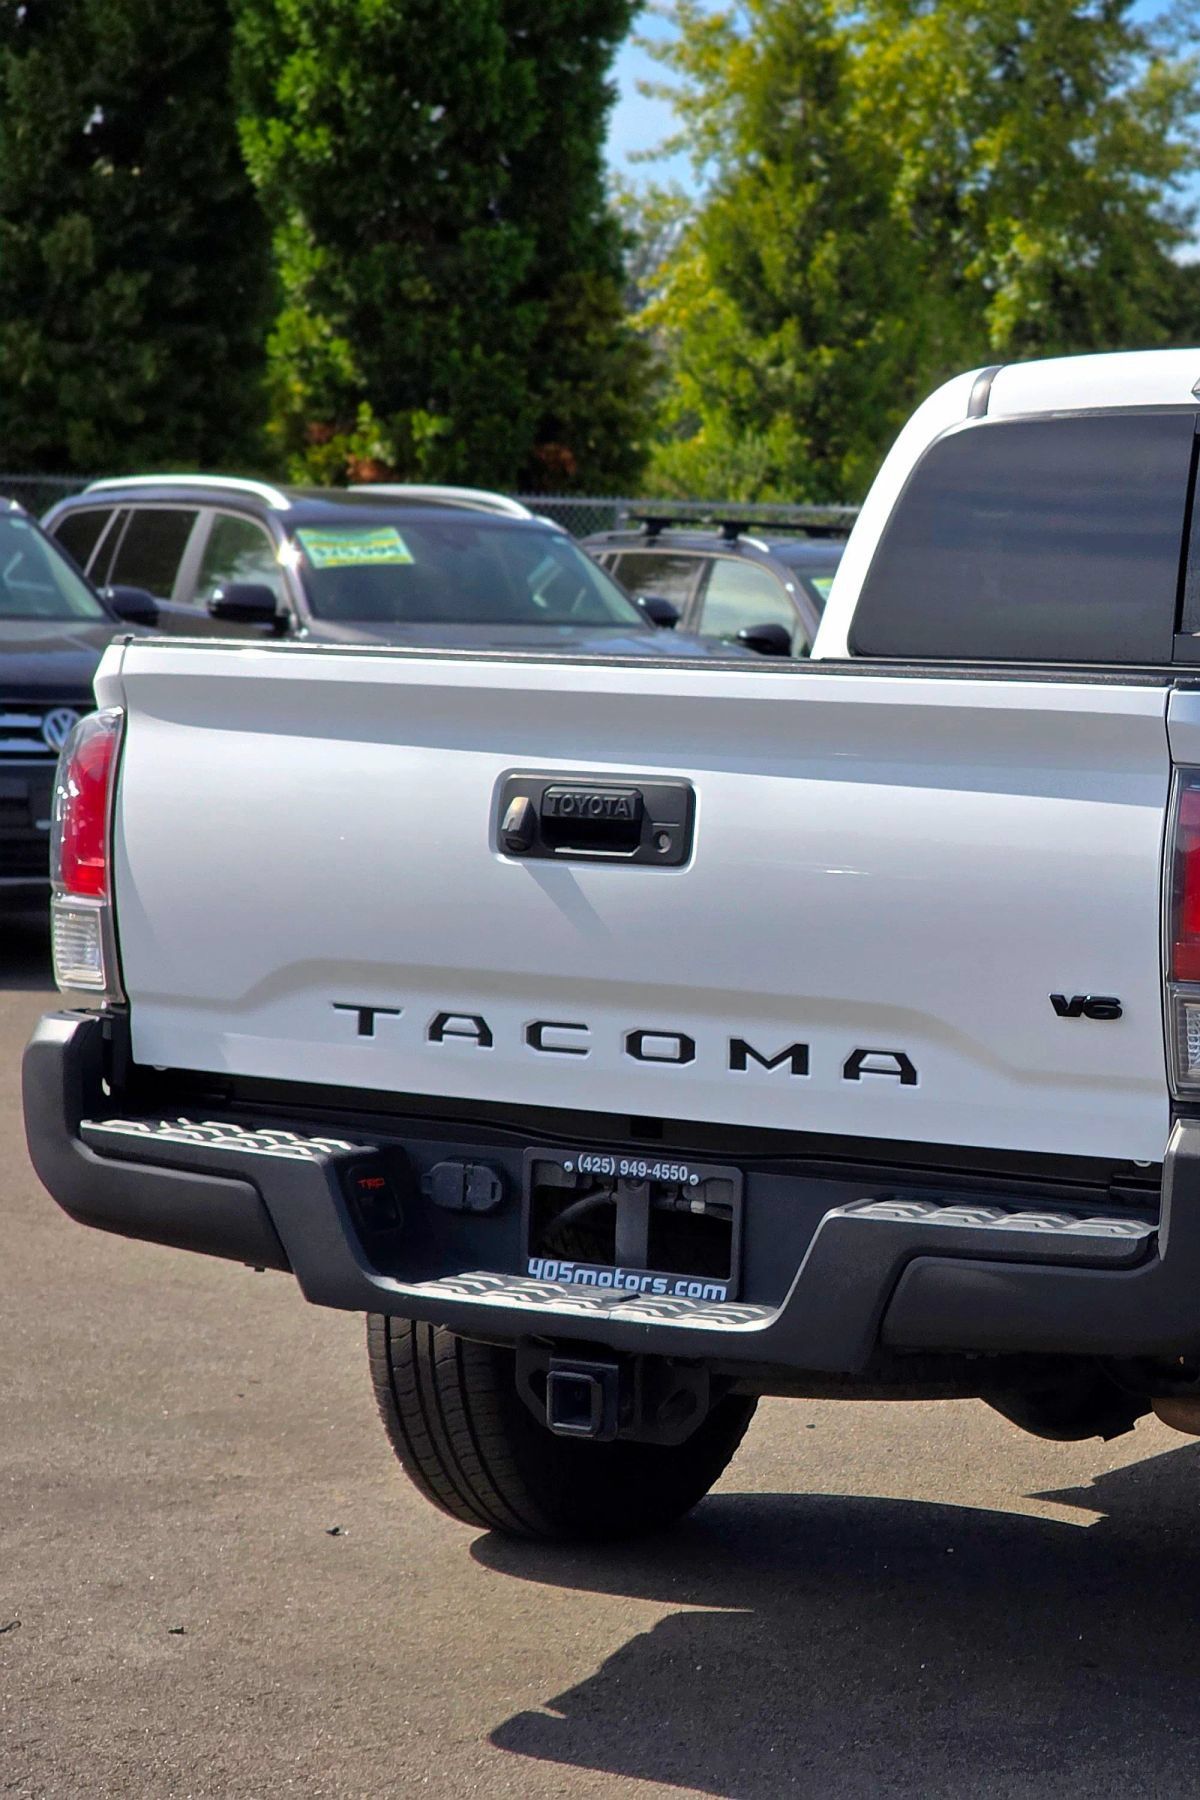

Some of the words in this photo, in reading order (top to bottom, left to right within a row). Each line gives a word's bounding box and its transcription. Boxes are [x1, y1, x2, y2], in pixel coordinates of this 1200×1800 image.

[550, 793, 631, 817] TOYOTA
[1048, 994, 1123, 1021] V6
[332, 1003, 920, 1086] TACOMA
[577, 1154, 616, 1176] (425)
[619, 1160, 689, 1182] 949-4550
[527, 1257, 728, 1302] 405motors.com
